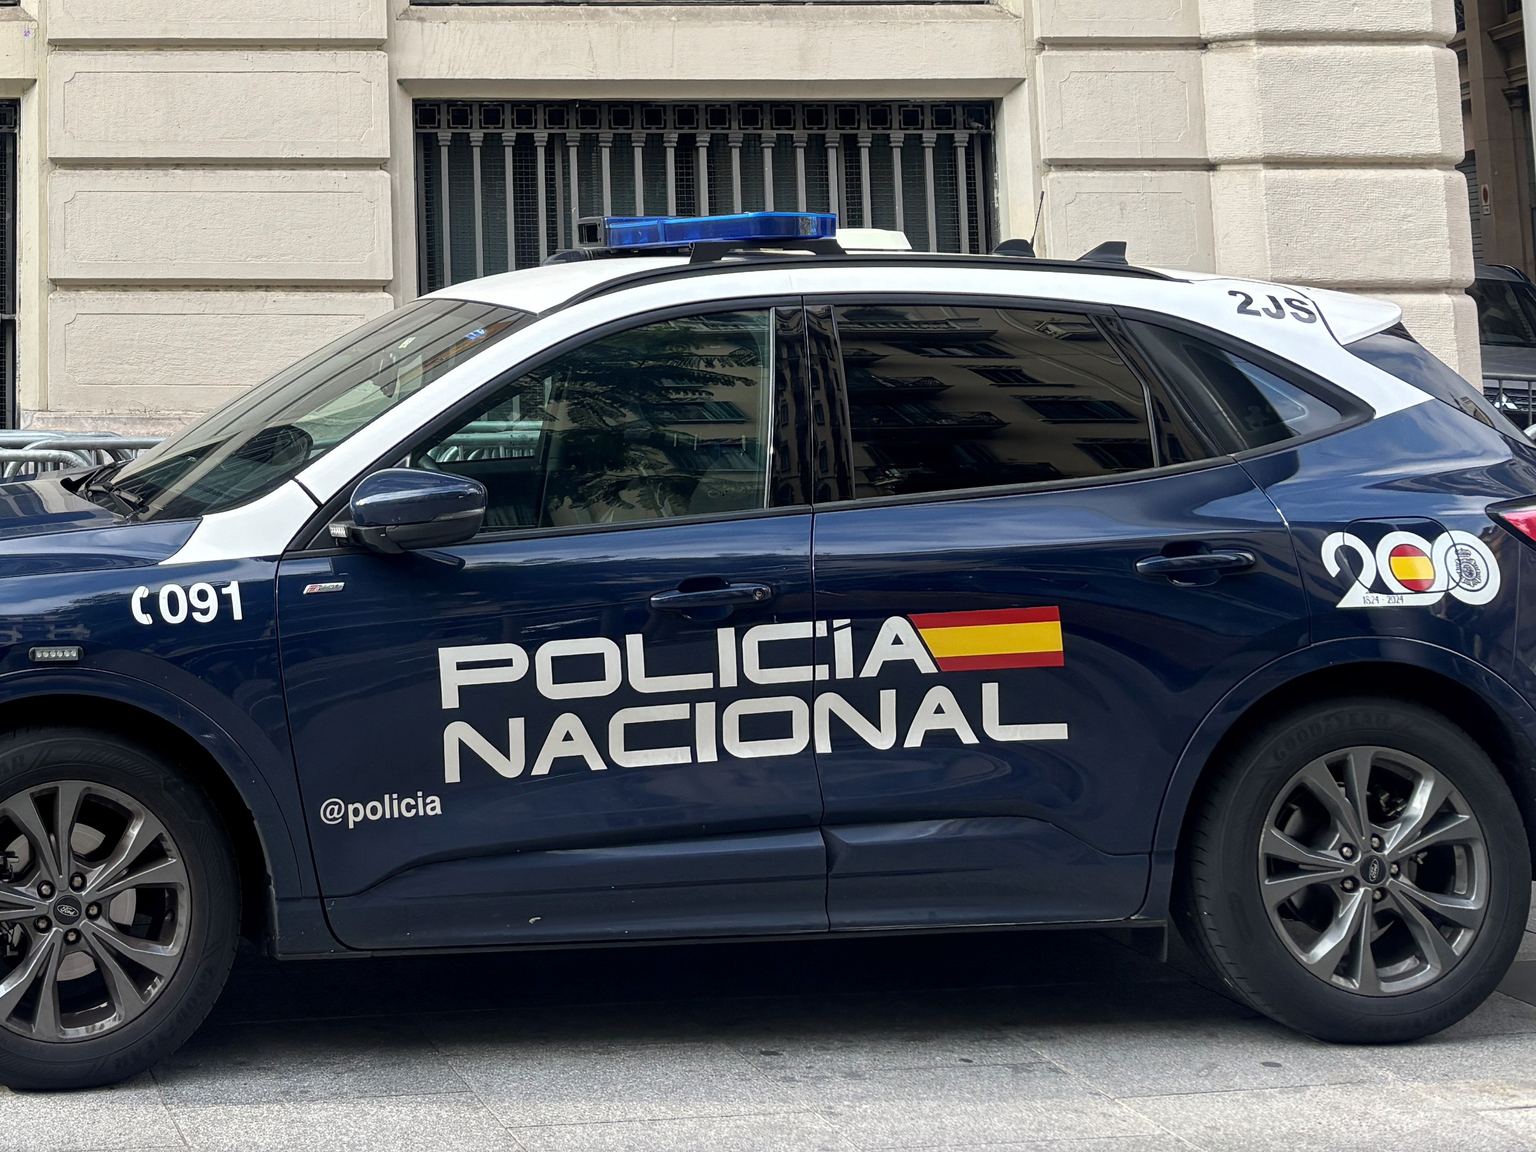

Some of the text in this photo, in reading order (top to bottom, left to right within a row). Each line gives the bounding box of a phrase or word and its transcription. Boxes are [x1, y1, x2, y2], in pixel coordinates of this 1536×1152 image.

[1227, 290, 1318, 324] 2JS
[1320, 530, 1502, 609] 200
[158, 580, 243, 625] 091
[442, 681, 1068, 783] NACIONAL
[319, 789, 442, 828] @policia
